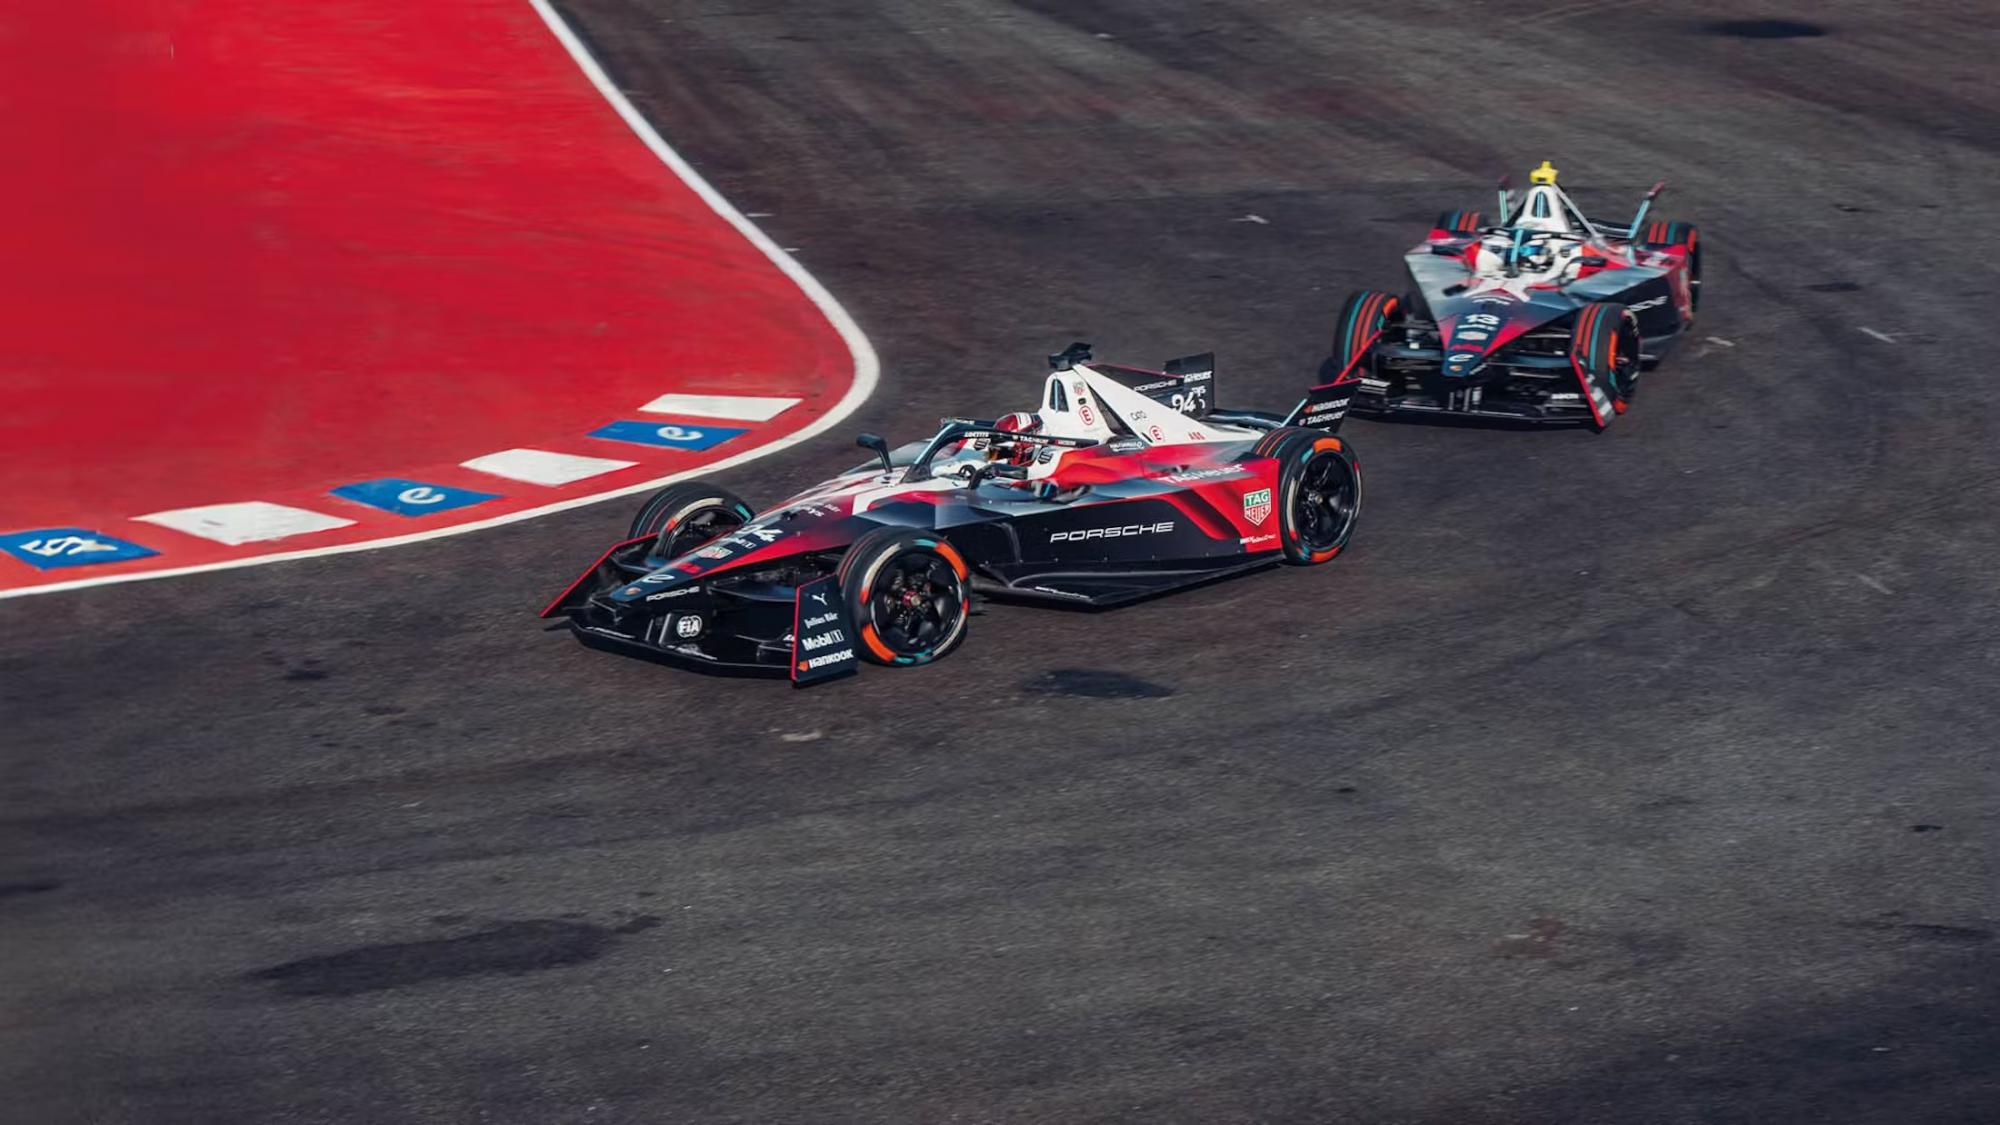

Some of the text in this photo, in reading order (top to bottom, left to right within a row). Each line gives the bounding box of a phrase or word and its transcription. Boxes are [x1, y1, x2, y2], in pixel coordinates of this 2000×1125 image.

[1465, 313, 1501, 325] 13
[1134, 379, 1177, 392] PORSCHE
[1171, 391, 1197, 414] 94
[1246, 490, 1270, 506] TAG
[1245, 502, 1271, 522] HEUER
[1050, 521, 1175, 543] PORSCHE
[646, 585, 700, 602] PORSCHE
[802, 632, 833, 651] Mobil
